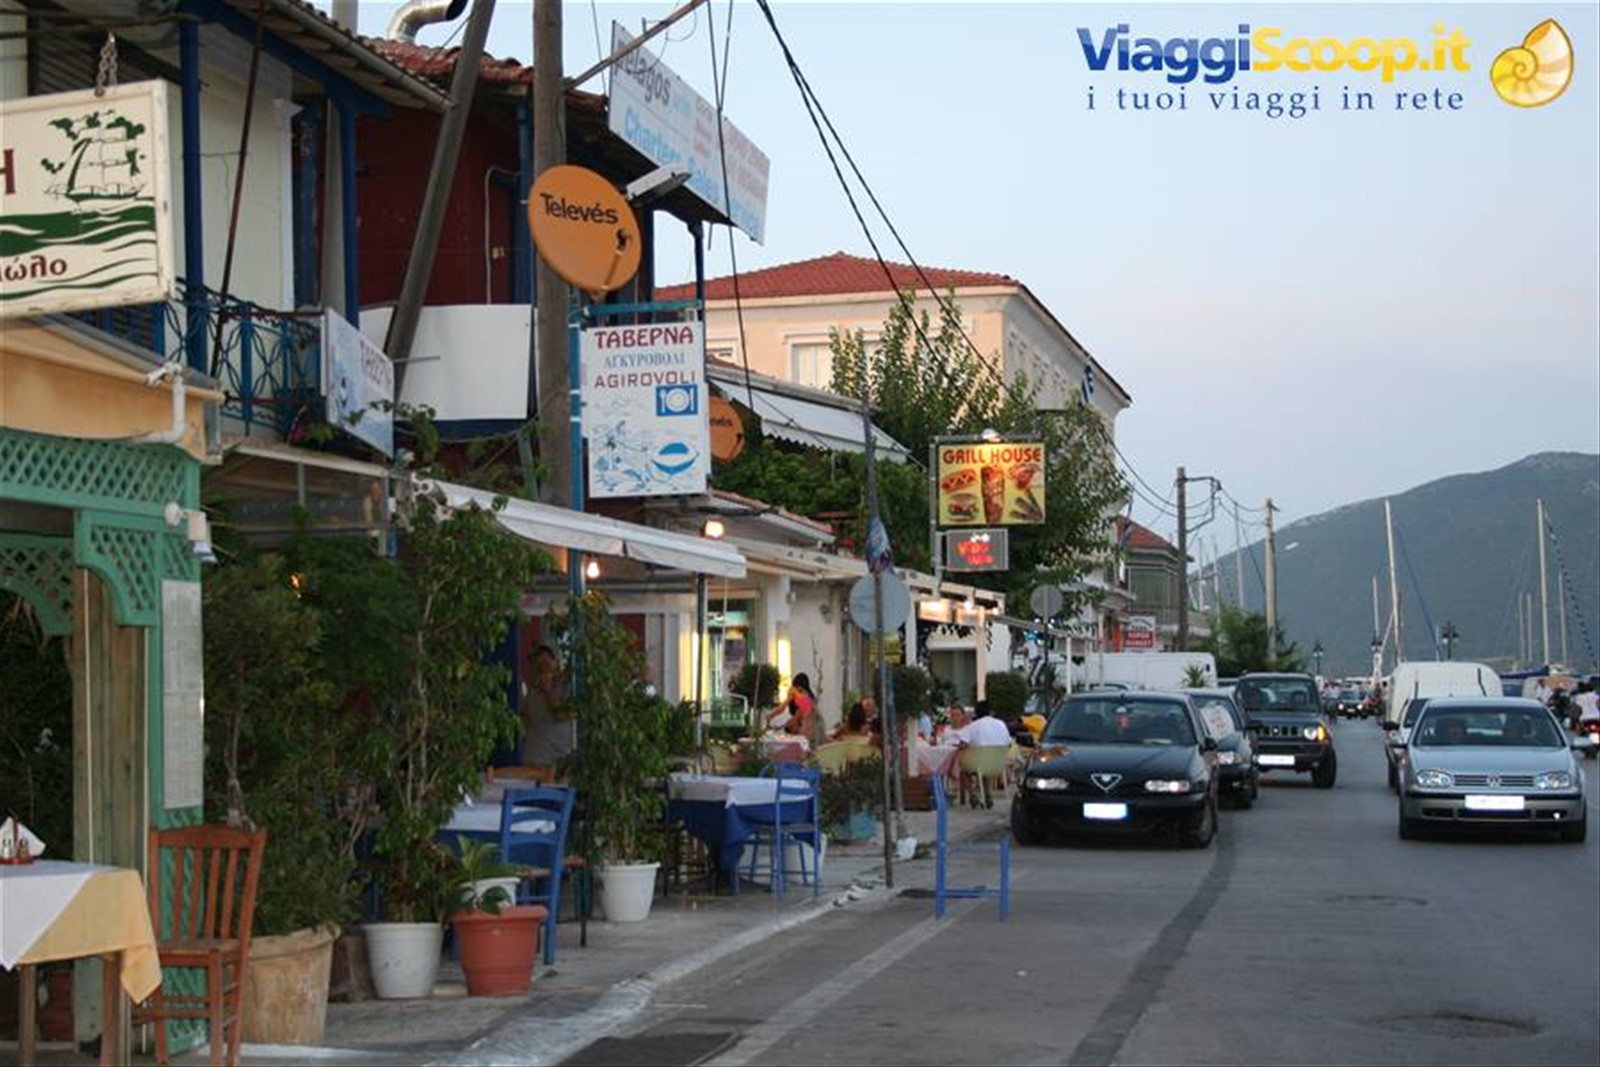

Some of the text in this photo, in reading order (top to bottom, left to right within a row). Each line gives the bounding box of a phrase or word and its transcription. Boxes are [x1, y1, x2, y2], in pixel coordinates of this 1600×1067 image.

[540, 192, 619, 224] Televés
[594, 371, 696, 389] AGIROVOLI
[943, 447, 1042, 464] GRILL HOUSE
